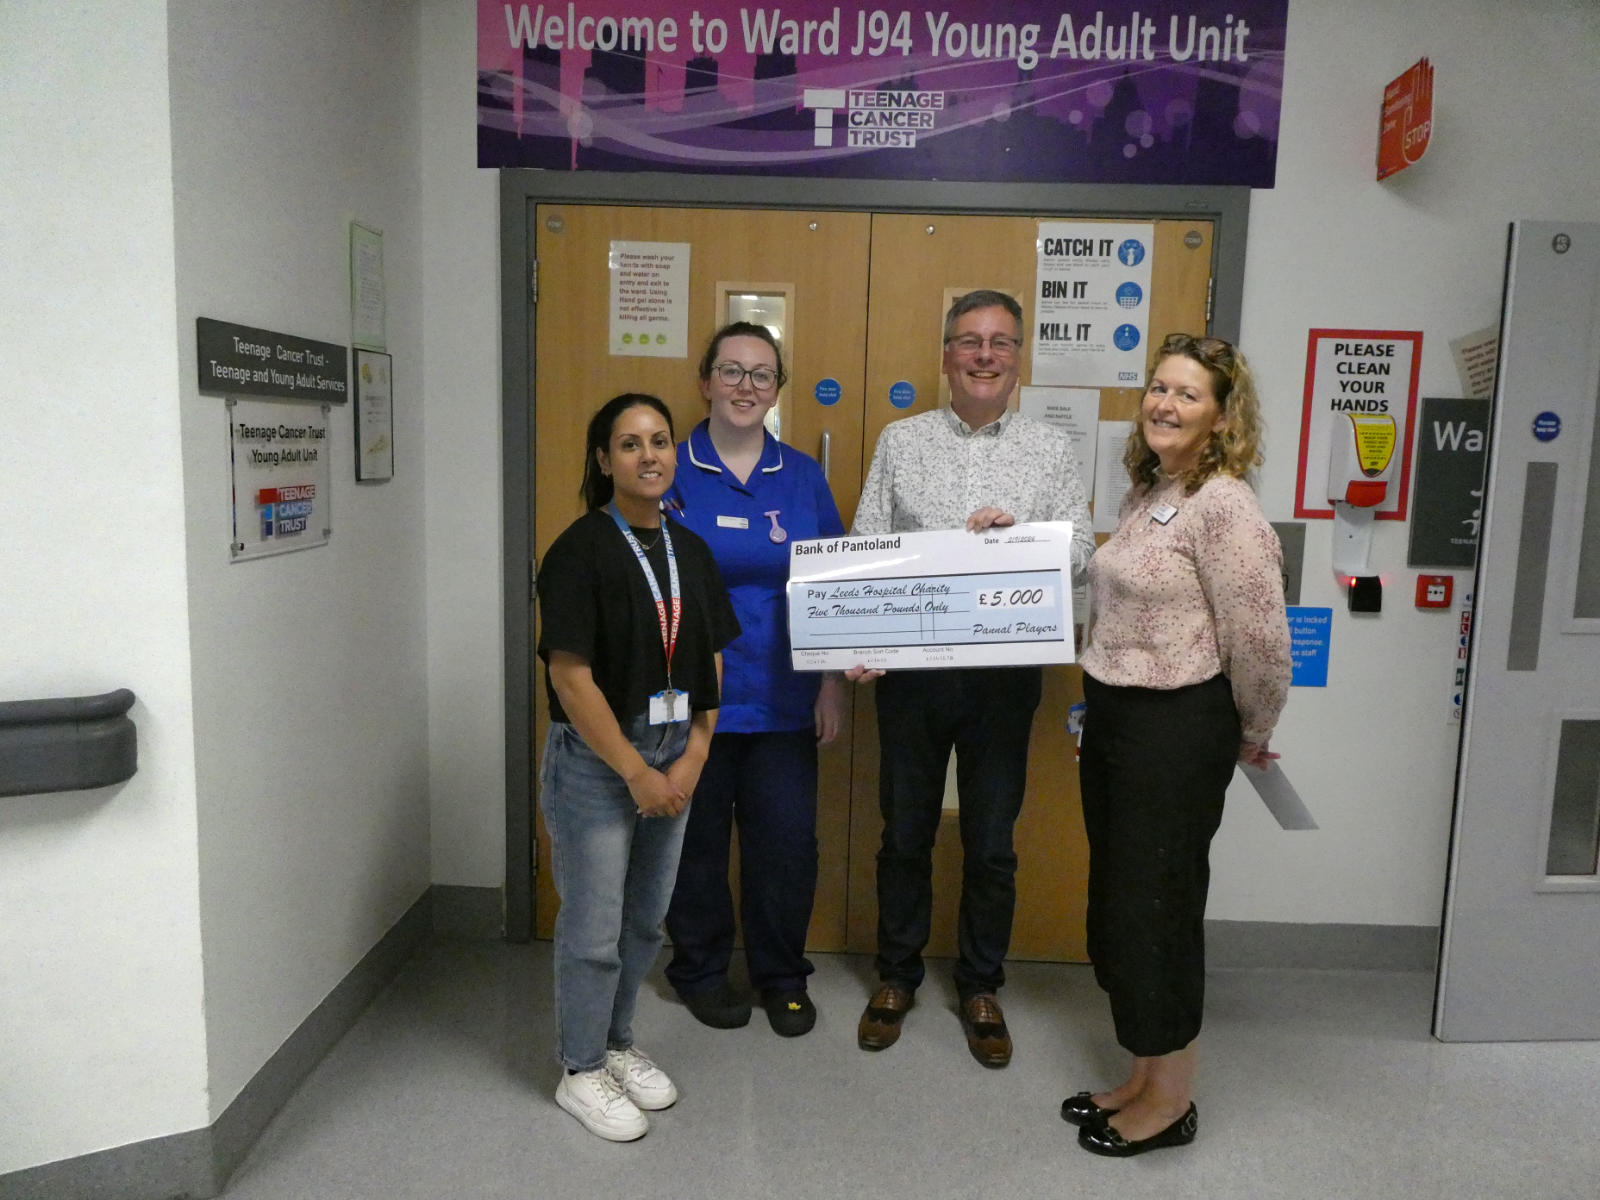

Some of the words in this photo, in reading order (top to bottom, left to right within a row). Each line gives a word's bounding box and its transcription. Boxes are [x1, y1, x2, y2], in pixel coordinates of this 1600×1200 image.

[504, 2, 678, 51] Welcome
[690, 10, 728, 54] to
[740, 7, 841, 55] Ward
[851, 9, 913, 57] J94
[925, 11, 1041, 70] Young
[1050, 11, 1156, 61] Adult
[1169, 13, 1250, 62] Unit
[850, 92, 943, 109] TEENAGE
[850, 110, 933, 127] CANCER
[849, 130, 915, 146] TRUST
[1043, 238, 1094, 257] CATCH
[1098, 239, 1114, 257] IT
[1041, 280, 1068, 299] BIN
[1073, 281, 1088, 299] IT
[1039, 323, 1072, 341] KILL
[1076, 323, 1091, 342] IT
[233, 336, 271, 361] Teenage
[276, 345, 304, 363] Cancer
[306, 350, 324, 366] Trust
[1334, 343, 1395, 357] PLEASE
[210, 360, 251, 384] Teenage
[252, 369, 269, 383] and
[270, 369, 295, 390] Young
[295, 374, 316, 389] Adult
[317, 375, 345, 392] Services
[1336, 361, 1391, 375] CLEAN
[1340, 380, 1385, 394] YOUR
[1330, 398, 1389, 412] HANDS
[239, 424, 277, 441] Teenage
[278, 425, 306, 438] Cancer
[308, 426, 326, 439] Trust
[252, 449, 279, 466] Young
[281, 448, 301, 462] Adult
[302, 449, 318, 462] Unit
[279, 485, 316, 501] TEENAGE
[280, 518, 306, 533] TRUST
[795, 543, 824, 556] Bank
[827, 541, 839, 553] of
[842, 537, 901, 553] Pantoland
[807, 590, 827, 600] Pay
[830, 587, 860, 598] Leeds
[862, 584, 907, 598] Hospital
[911, 582, 950, 595] Charity
[807, 606, 828, 618] Five
[832, 604, 879, 617] Thousand
[883, 602, 920, 615] Pounds
[924, 601, 949, 614] Only
[656, 601, 668, 648] TEENAGE
[670, 598, 681, 645] TEENAGE
[973, 624, 1012, 636] Pannal
[1015, 621, 1057, 635] Players
